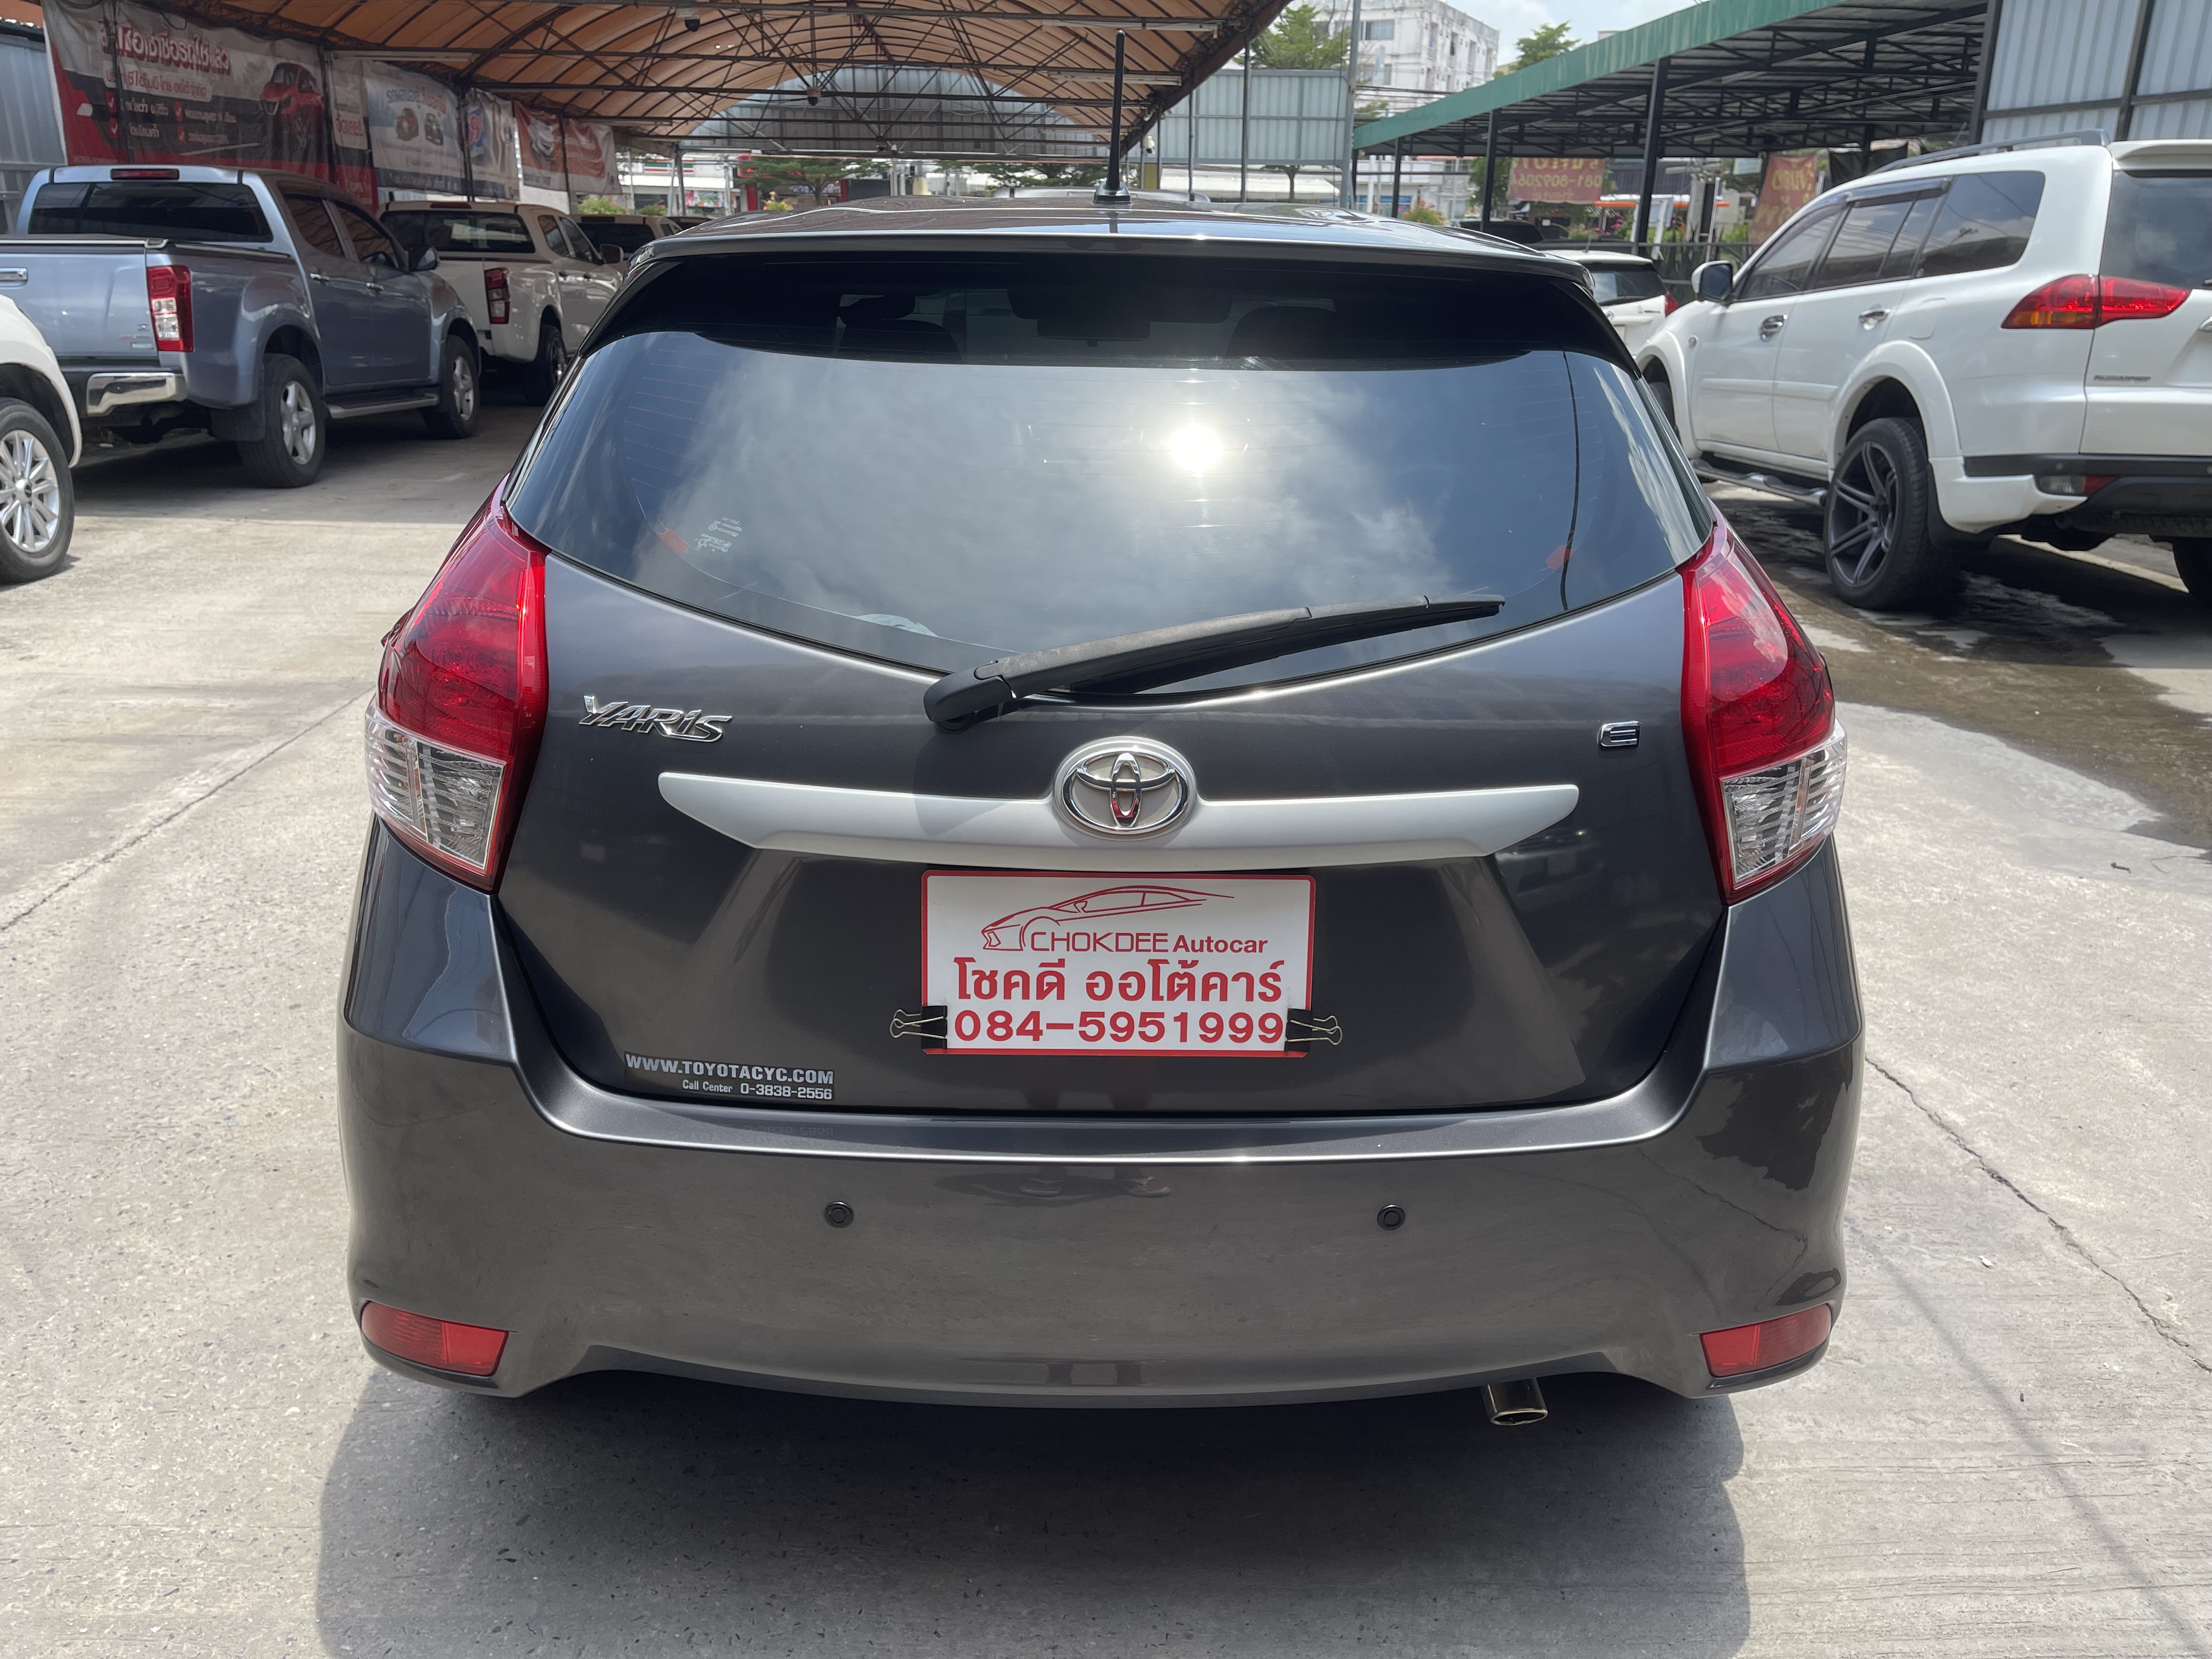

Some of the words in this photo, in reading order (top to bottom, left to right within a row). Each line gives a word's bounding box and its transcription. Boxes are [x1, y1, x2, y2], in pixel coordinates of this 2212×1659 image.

[1598, 720, 1640, 747] E
[1030, 931, 1169, 953] CHOKDEE
[1172, 934, 1268, 953] Autocar
[953, 957, 1065, 1001] โชคดี
[1085, 958, 1285, 1002] ออโต้คาร์
[954, 1009, 1284, 1043] 084-5951999
[625, 1053, 834, 1085] WWW.TOYOTACYC.COM
[682, 1079, 699, 1091] Call
[702, 1081, 733, 1093] Center
[740, 1082, 833, 1101] 0-3838-2556
